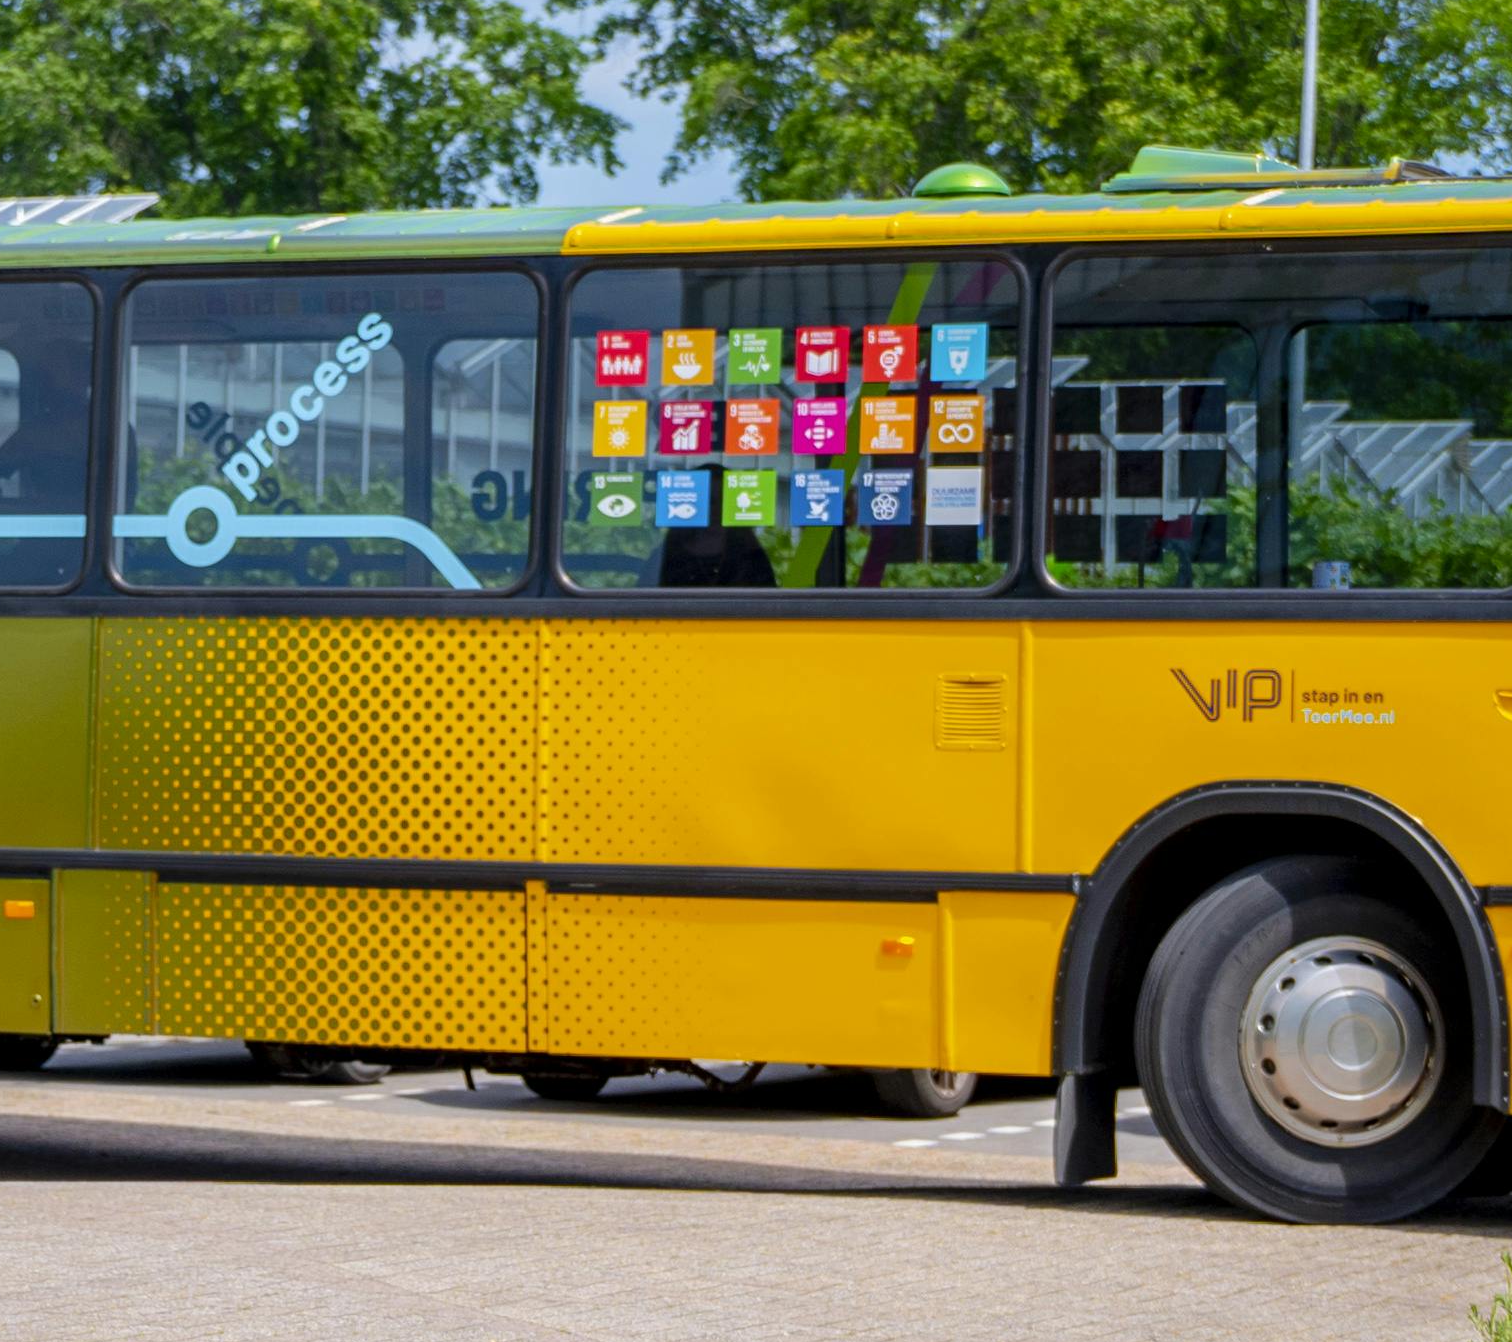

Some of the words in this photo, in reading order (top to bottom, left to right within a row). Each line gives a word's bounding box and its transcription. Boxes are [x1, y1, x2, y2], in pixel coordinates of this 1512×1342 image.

[602, 336, 609, 349] 1
[667, 335, 674, 348] 2
[733, 334, 740, 347] 3
[800, 332, 808, 345] 4
[221, 312, 394, 502] process
[664, 405, 671, 418] 8
[730, 404, 737, 417] 9
[797, 402, 808, 416] 10
[865, 402, 874, 415] 11
[934, 401, 944, 414] 12
[863, 473, 873, 487] 17
[1169, 668, 1282, 722] VIP
[1302, 690, 1340, 706] stap
[1344, 688, 1359, 703] in
[1363, 691, 1384, 703] en
